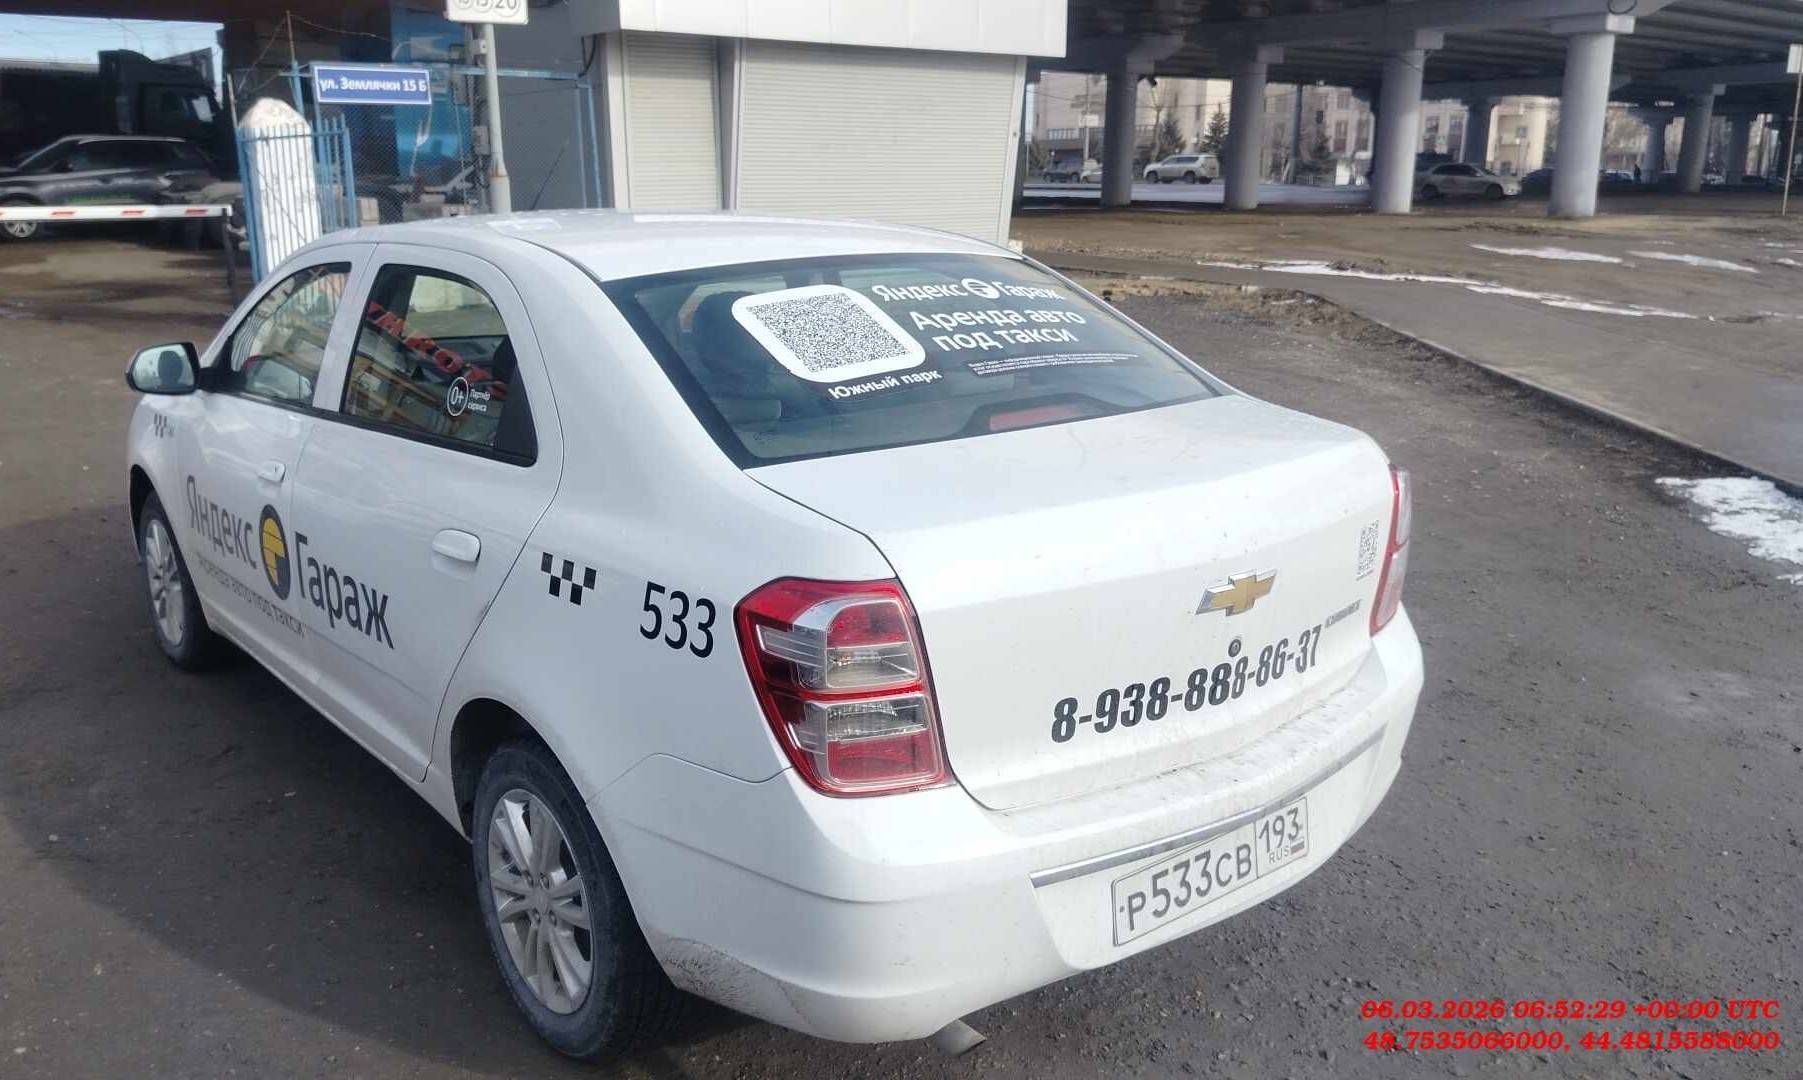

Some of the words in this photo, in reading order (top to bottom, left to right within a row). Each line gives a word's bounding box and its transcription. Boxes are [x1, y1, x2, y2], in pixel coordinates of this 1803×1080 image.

[320, 79, 338, 92] ул.
[340, 77, 400, 91] Землячки
[402, 79, 416, 92] 15
[872, 282, 968, 302] Яндекс
[993, 281, 1066, 300] Гараж
[909, 308, 1027, 332] Аренда
[1022, 308, 1087, 325] авто
[932, 332, 1003, 352] под
[1001, 328, 1080, 346] такси
[450, 386, 464, 405] 0+
[828, 374, 901, 399] Южный
[900, 370, 943, 384] парк
[187, 475, 257, 570] Яндекс
[295, 531, 395, 650] Гараж
[640, 580, 716, 658] 533
[1051, 624, 1322, 743] 8-938-888-86-37
[1268, 845, 1290, 865] RUS
[1127, 843, 1252, 931] Р533СВ
[1258, 807, 1299, 854] 193
